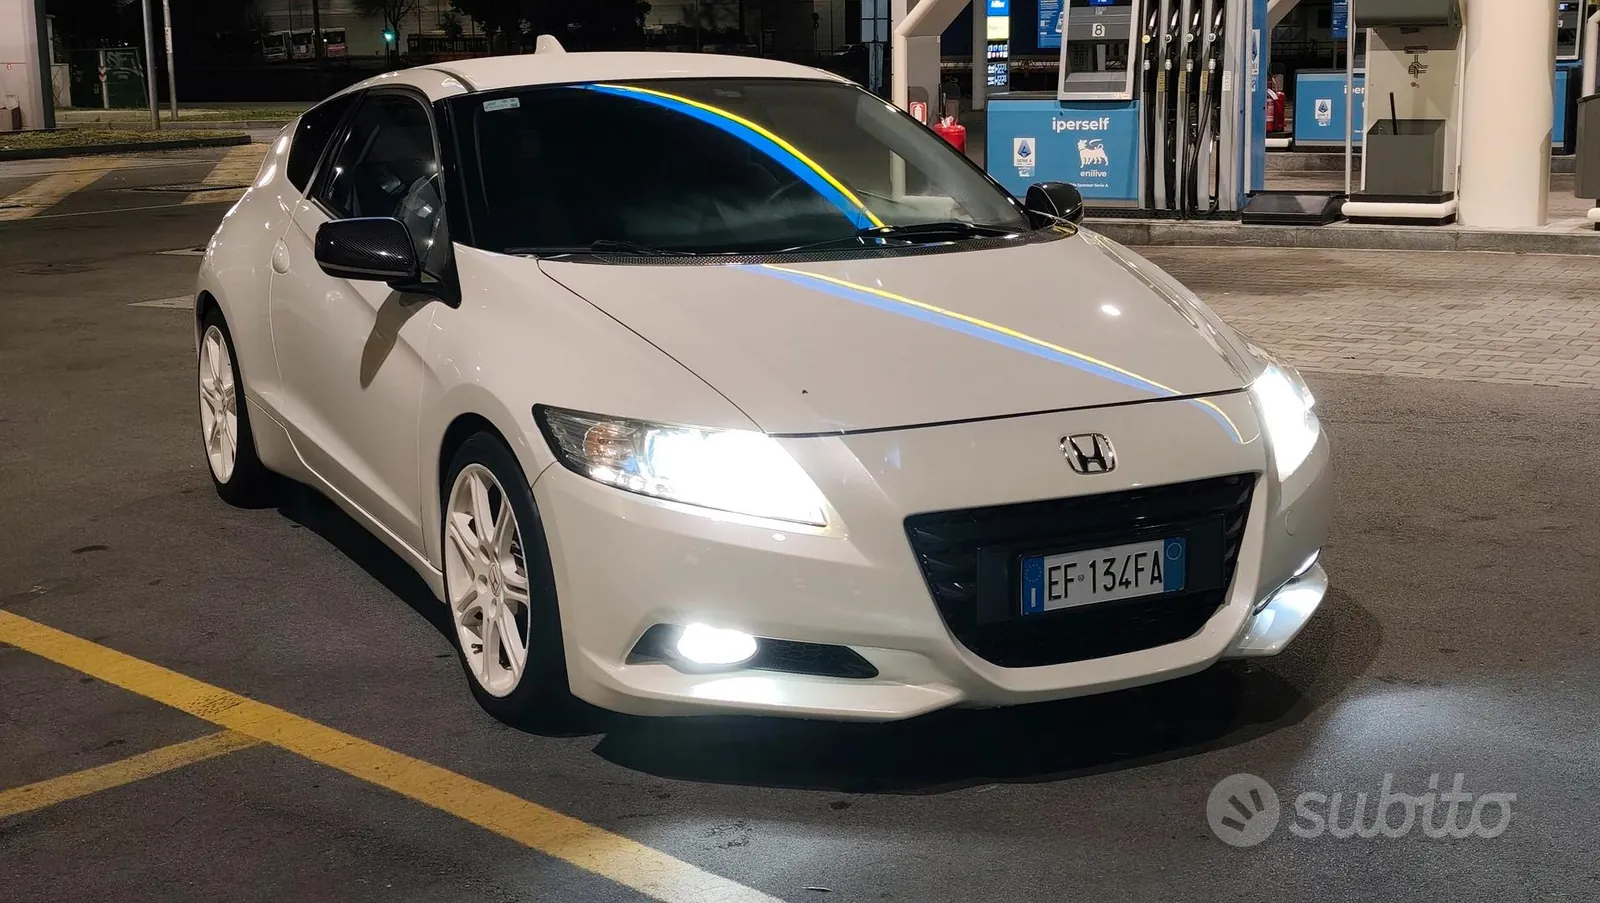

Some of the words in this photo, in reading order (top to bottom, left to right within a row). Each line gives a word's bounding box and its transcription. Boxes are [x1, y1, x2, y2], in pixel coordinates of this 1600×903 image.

[1094, 24, 1103, 36] 8
[1052, 117, 1110, 133] iperself
[1080, 169, 1108, 178] enilive
[1047, 562, 1077, 602] EF
[1088, 550, 1164, 595] 134FA
